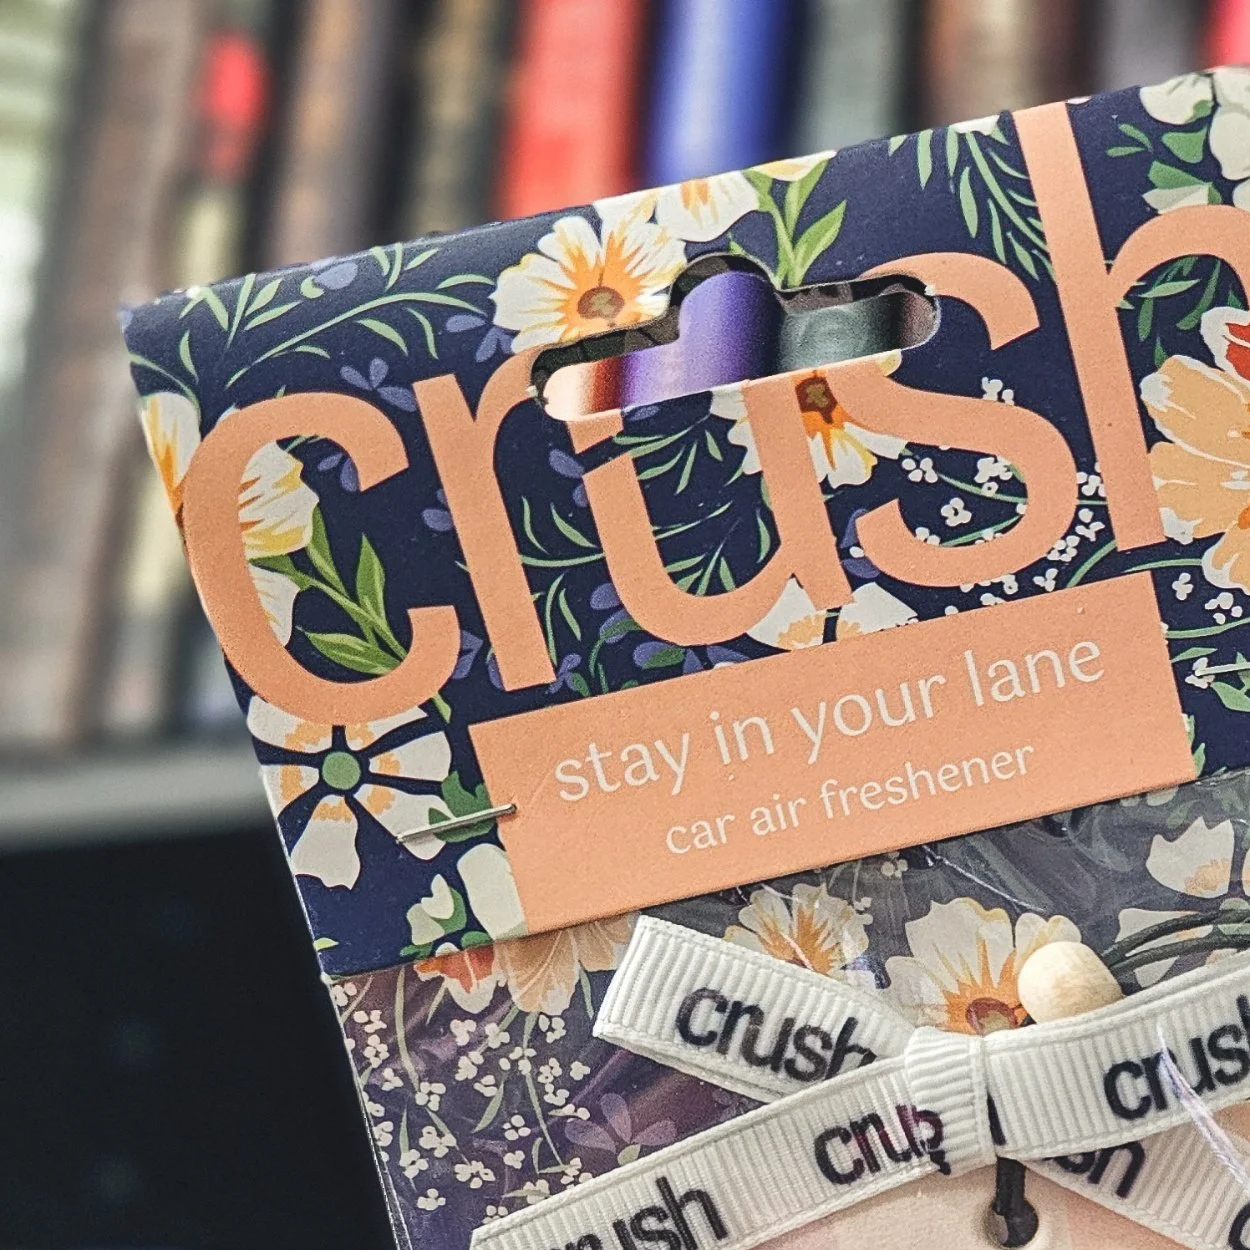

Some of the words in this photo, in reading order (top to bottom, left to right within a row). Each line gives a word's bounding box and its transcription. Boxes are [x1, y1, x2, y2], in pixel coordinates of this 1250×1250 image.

[553, 732, 690, 802] stay
[709, 710, 775, 766] in
[790, 672, 947, 765] your
[964, 640, 1106, 708] lane
[665, 810, 736, 855] car
[750, 794, 807, 839] air
[817, 743, 1036, 821] freshener
[675, 987, 877, 1082] crush
